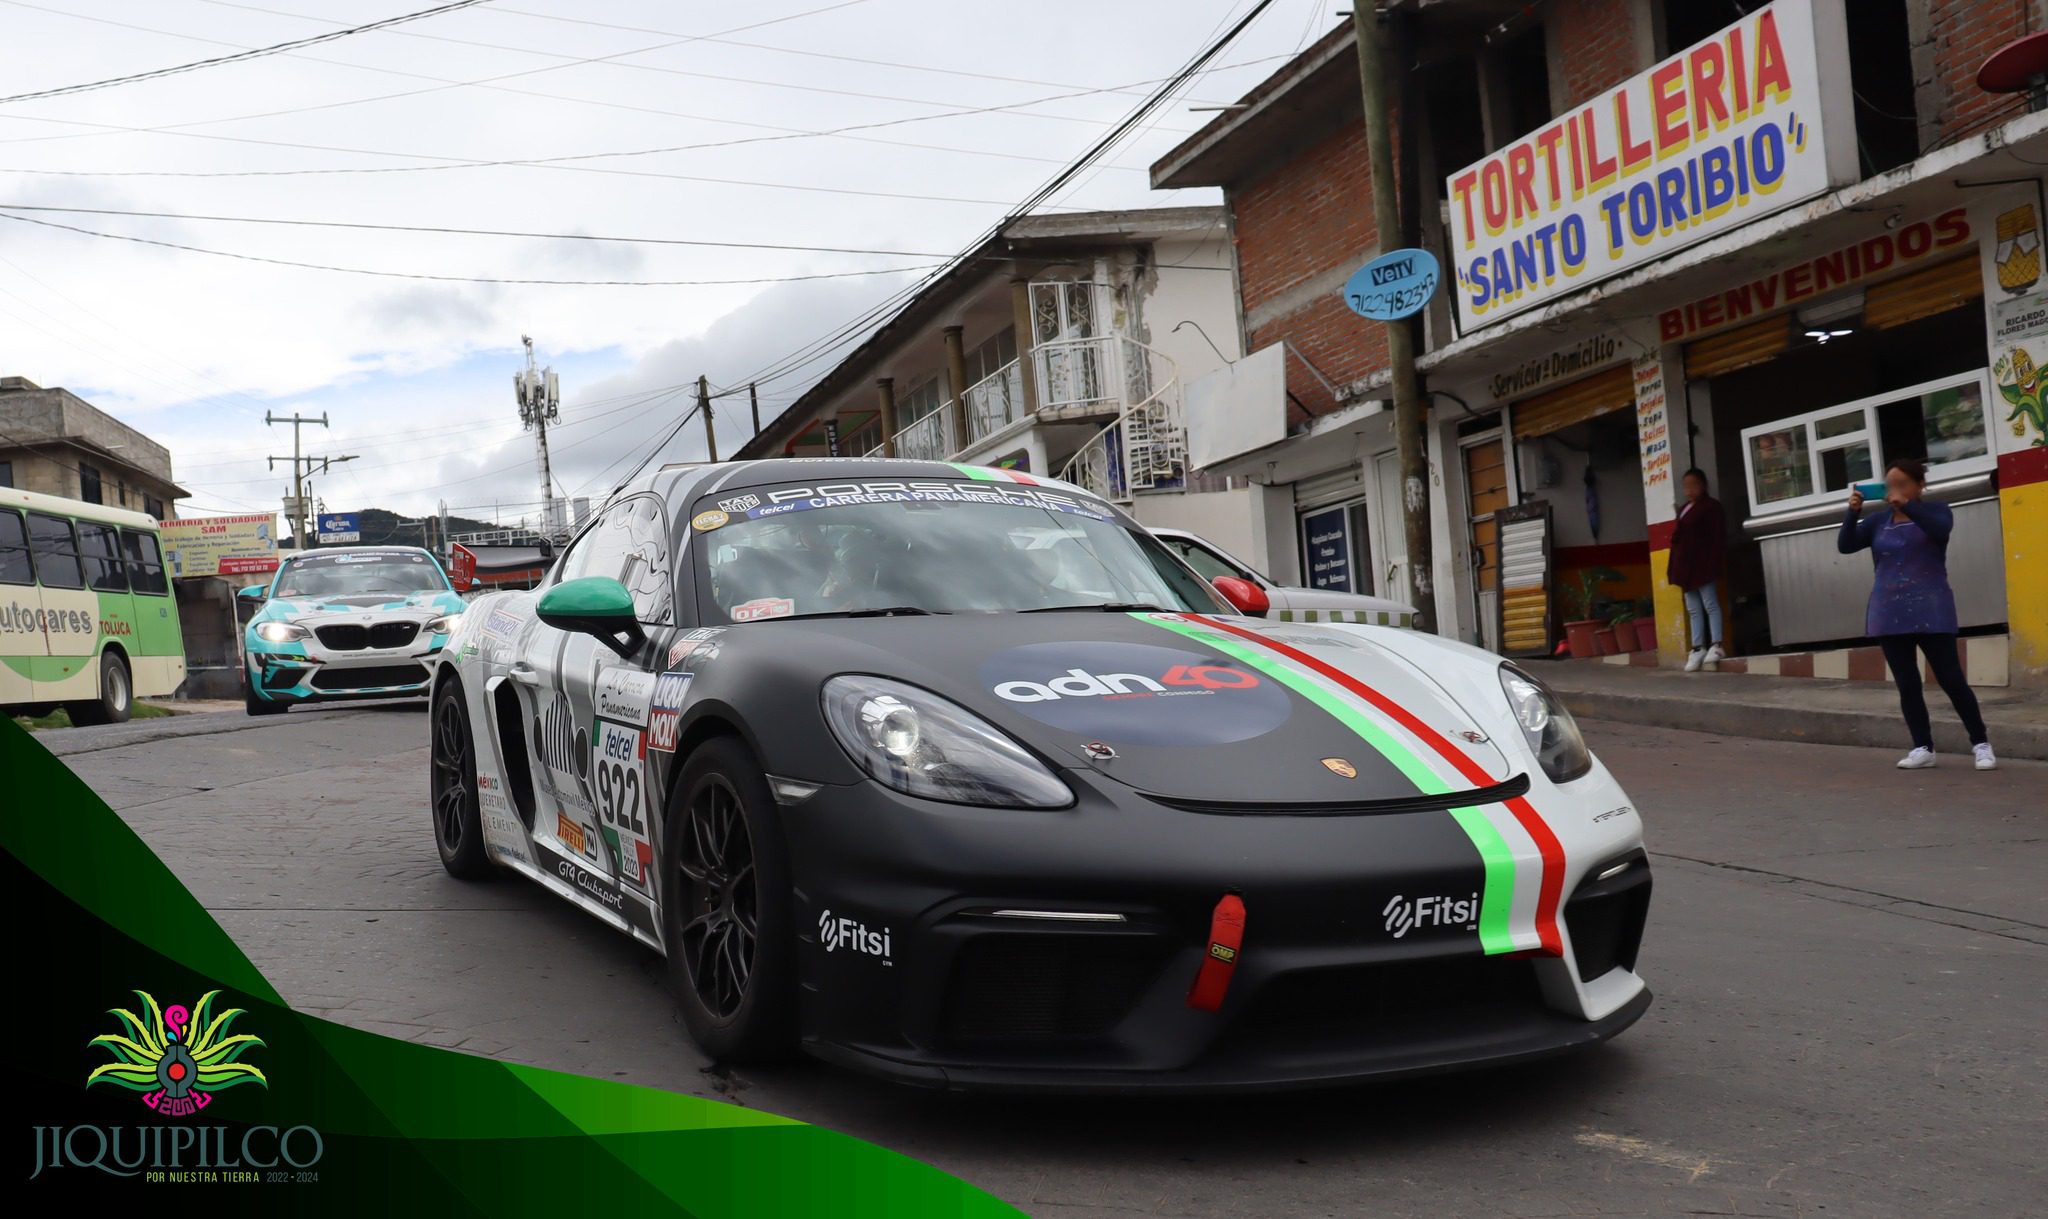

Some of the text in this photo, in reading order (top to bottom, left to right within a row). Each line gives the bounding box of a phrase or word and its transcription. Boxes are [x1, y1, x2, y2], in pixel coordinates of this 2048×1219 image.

[1453, 8, 1792, 250] TORTILLERIA
[1658, 207, 1971, 342] BIENVENIDOS
[1997, 322, 2026, 336] FLORES
[2005, 310, 2046, 327] RICARDO
[1551, 334, 1615, 377] Domicilio
[1647, 439, 1667, 456] Masa
[759, 503, 795, 516] telcel
[809, 492, 910, 508] CARRERA
[911, 491, 1064, 513] PANAMERICANA
[768, 482, 1080, 509] PORSCHE
[201, 526, 226, 534] SAM
[214, 515, 270, 525] SOLDADURA
[0, 601, 93, 634] utocares
[99, 620, 131, 636] TOLUCA
[652, 675, 692, 710] LIQUI
[605, 727, 635, 763] telcel
[650, 712, 679, 748] MOLY
[598, 759, 645, 836] 922
[558, 861, 623, 910] GT4 Clubsport
[1414, 892, 1478, 928] Fitsi
[838, 917, 891, 957] Fitsi
[1211, 946, 1234, 959] OMP
